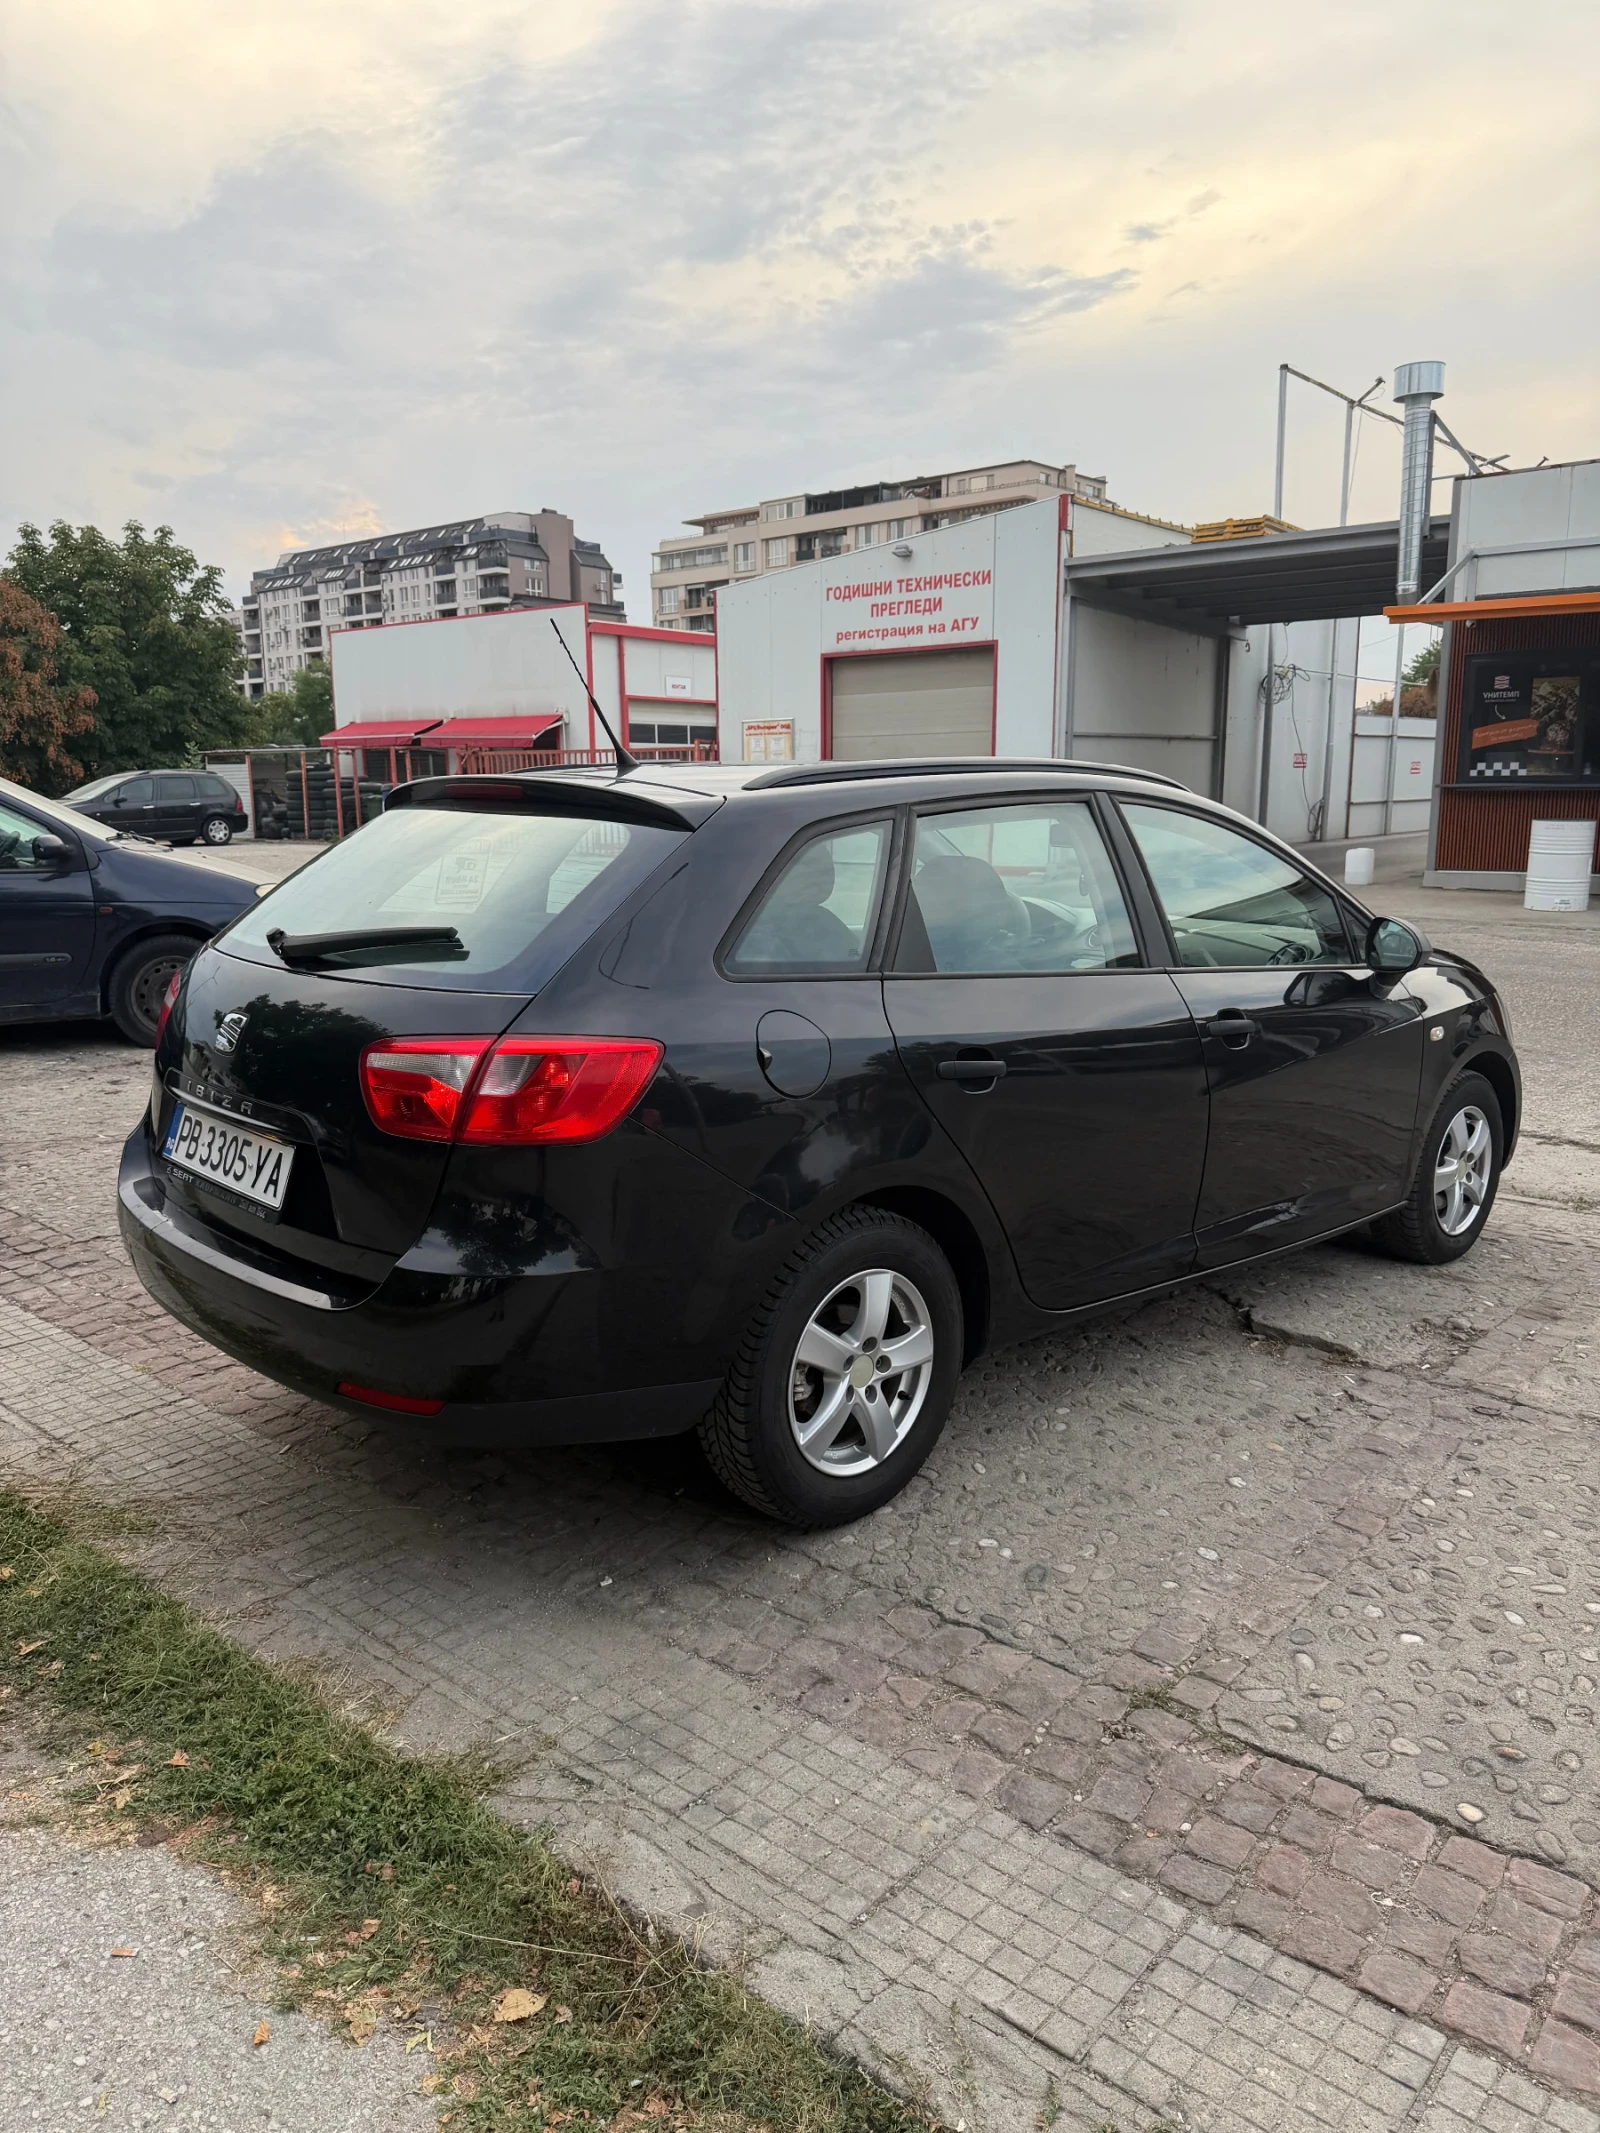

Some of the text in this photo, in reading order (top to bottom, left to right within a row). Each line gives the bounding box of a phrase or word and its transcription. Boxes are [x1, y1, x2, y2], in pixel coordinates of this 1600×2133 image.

[825, 569, 992, 602] ГОДИШНИ ТЕХНИЧЕСКИ
[870, 597, 943, 618] ПРЕГЛЕДИ
[836, 616, 980, 644] регистрация на АГУ
[1482, 690, 1520, 699] УНИТЕМП
[186, 1080, 254, 1116] IBIZA
[166, 1136, 175, 1151] BG
[172, 1168, 195, 1183] SEAT
